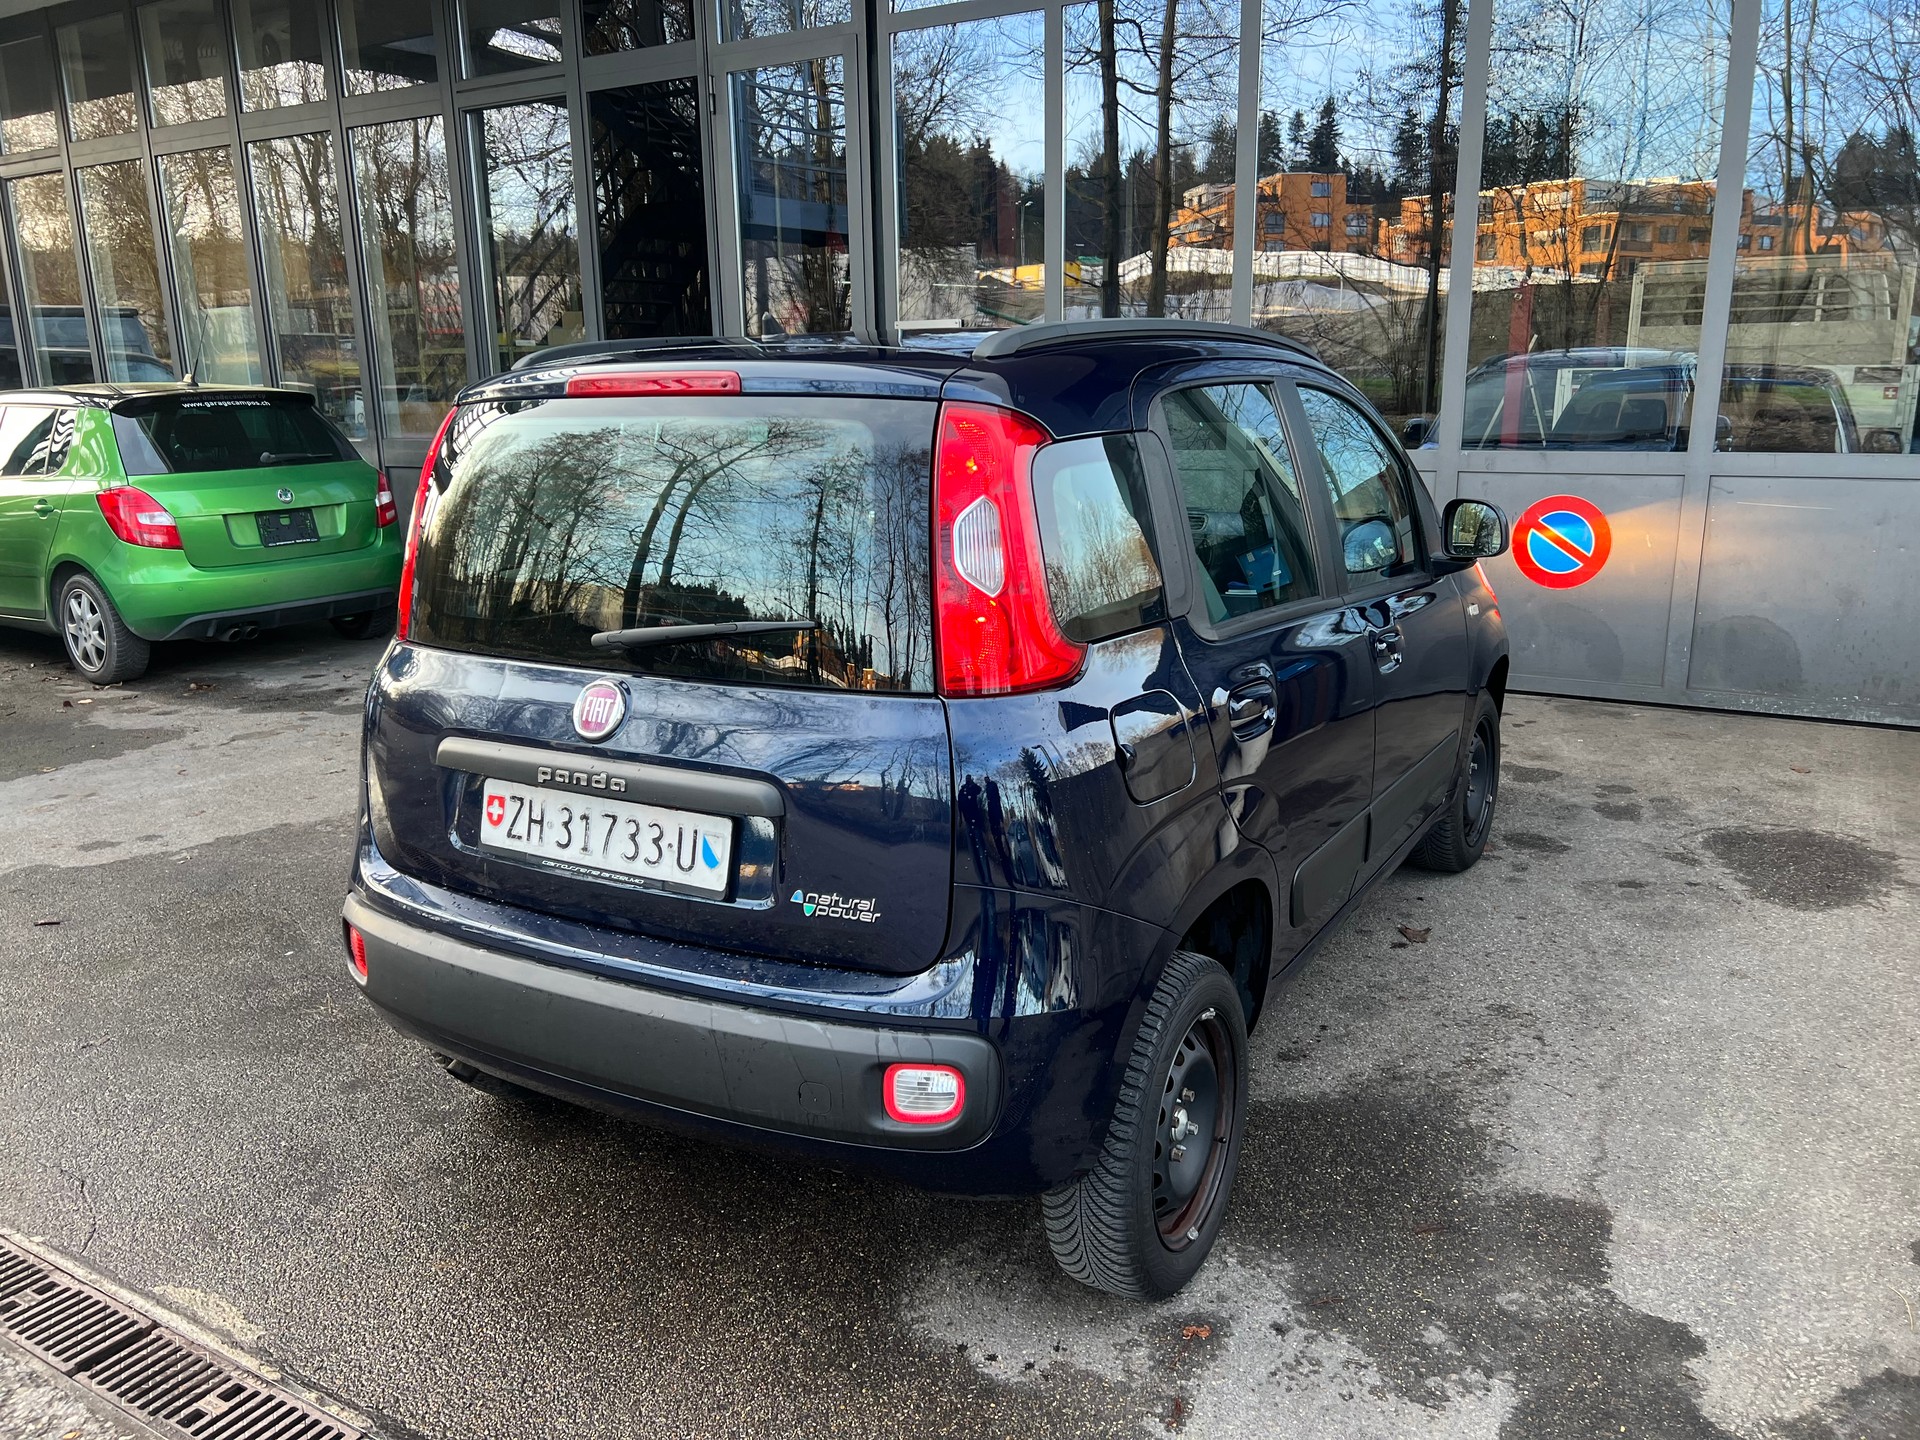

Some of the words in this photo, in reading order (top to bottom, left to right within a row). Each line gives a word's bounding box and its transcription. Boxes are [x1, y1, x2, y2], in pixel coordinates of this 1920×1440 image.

[582, 696, 613, 723] FIAT
[537, 765, 627, 792] panda
[805, 892, 876, 912] natural
[815, 906, 881, 923] power
